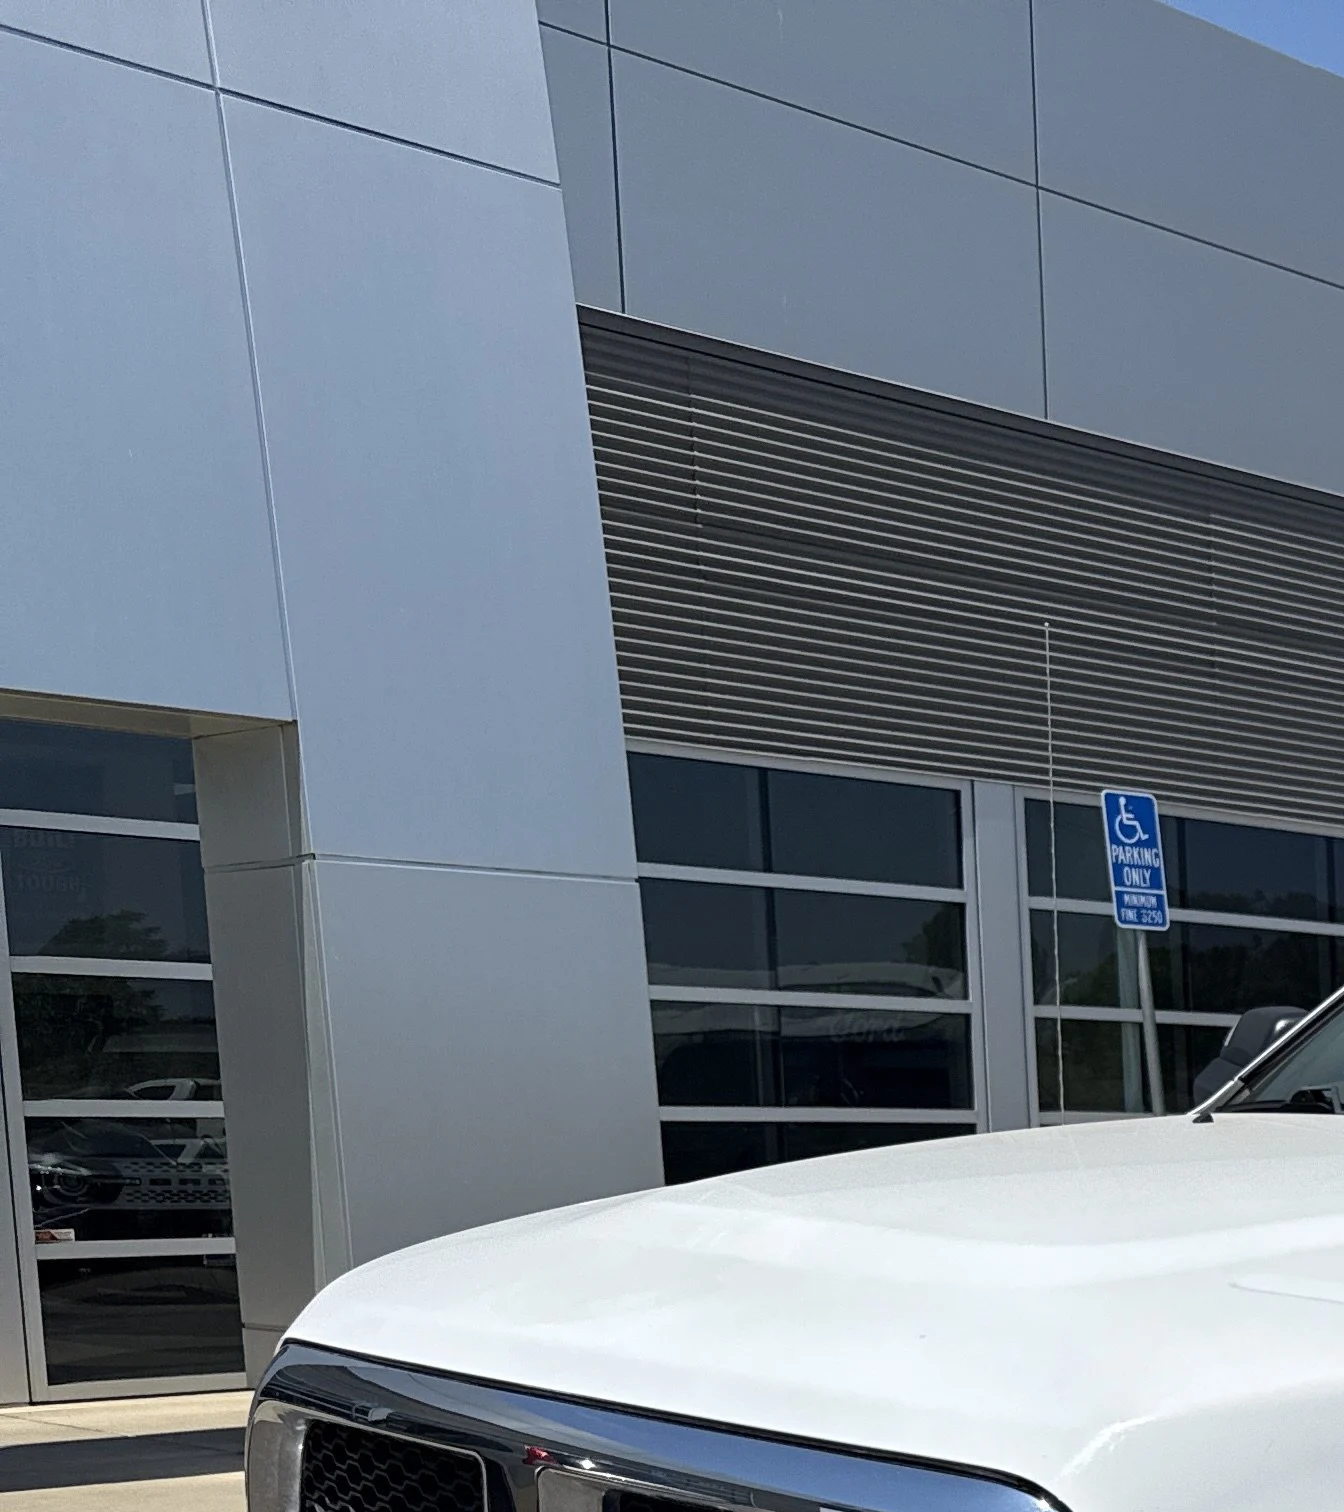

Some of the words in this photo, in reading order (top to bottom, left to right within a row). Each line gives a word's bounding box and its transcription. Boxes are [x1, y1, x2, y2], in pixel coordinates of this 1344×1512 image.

[1111, 844, 1160, 868] PARKING
[1123, 867, 1151, 888] ONLY
[1123, 893, 1158, 909] MINIMUM
[1120, 907, 1139, 923] FINE
